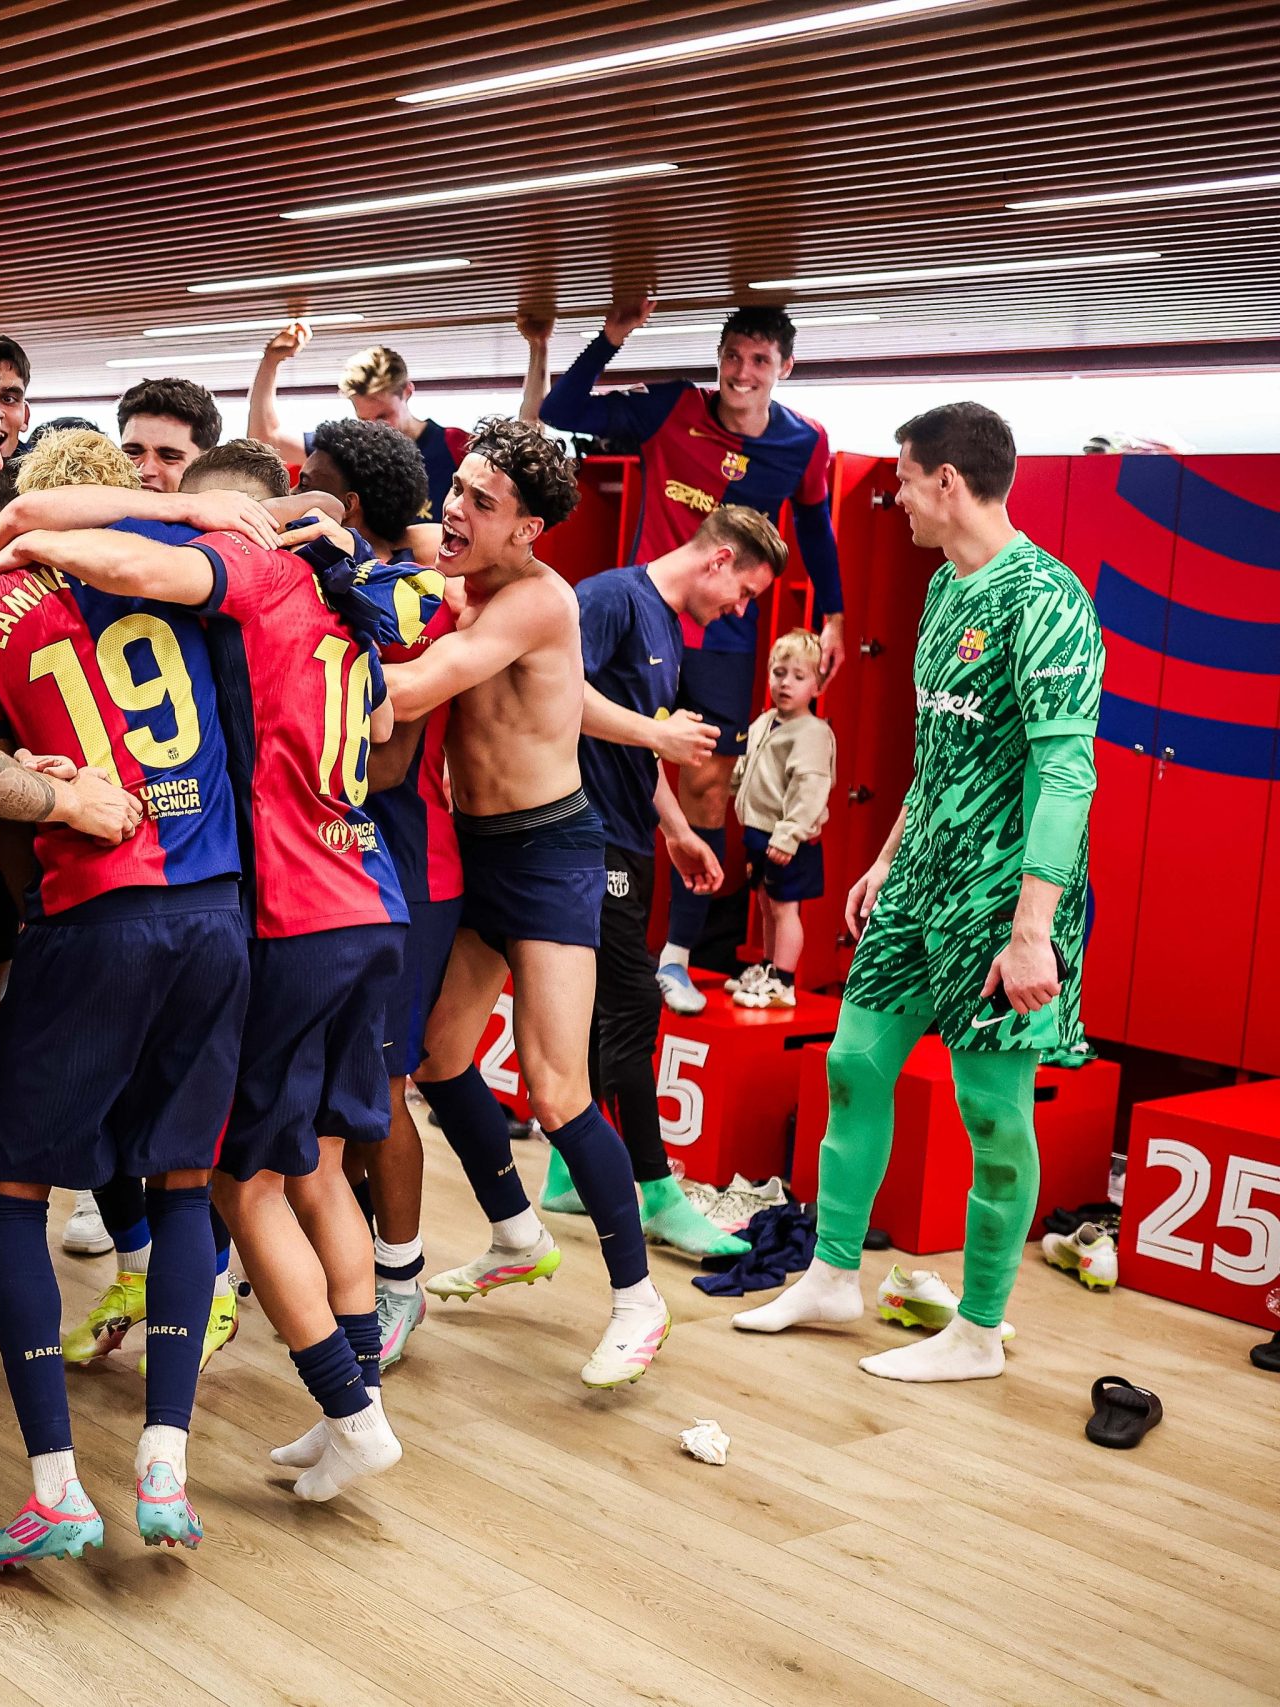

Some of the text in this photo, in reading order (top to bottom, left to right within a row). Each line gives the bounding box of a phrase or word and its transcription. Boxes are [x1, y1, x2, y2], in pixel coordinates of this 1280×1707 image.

[29, 613, 201, 788] 19
[313, 633, 370, 807] 16
[139, 778, 199, 800] UNHCR
[147, 793, 201, 815] ACNUR
[1136, 1138, 1280, 1286] 25
